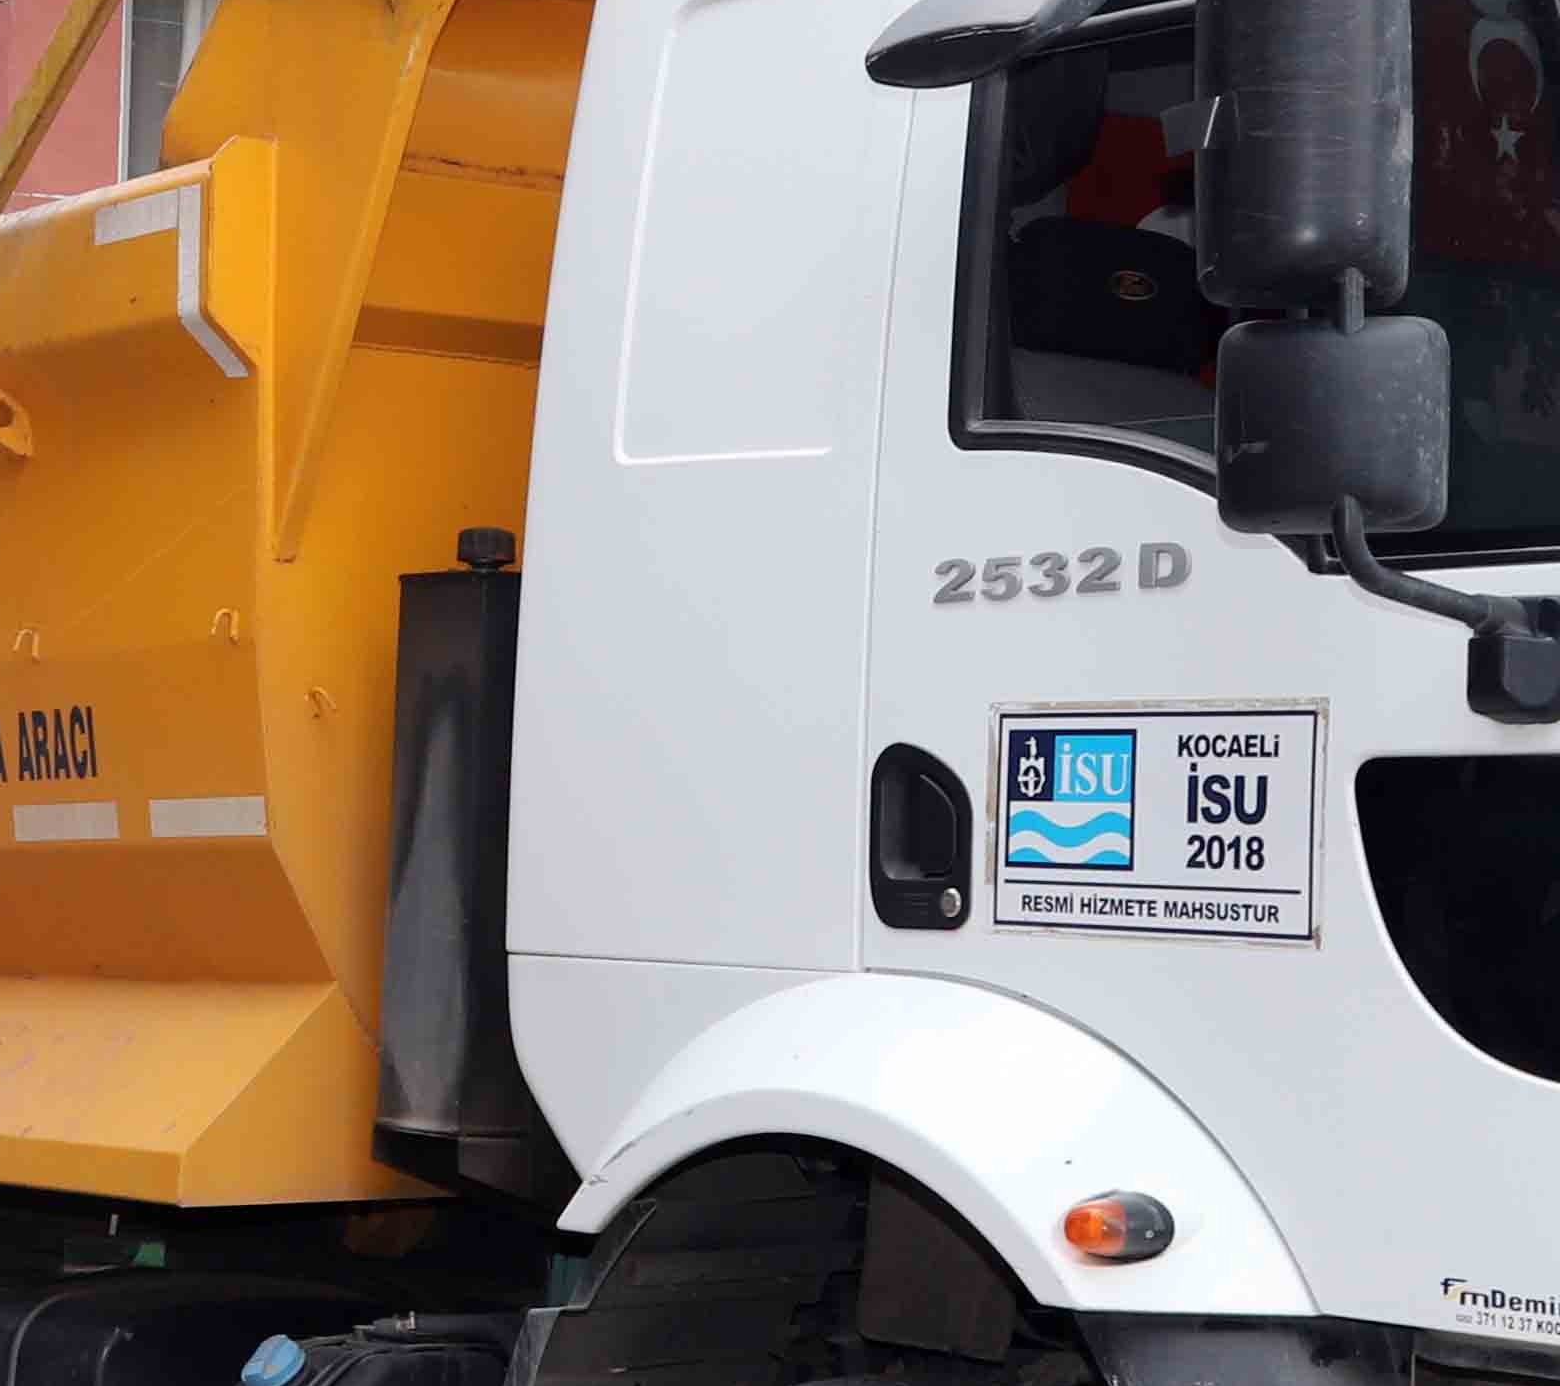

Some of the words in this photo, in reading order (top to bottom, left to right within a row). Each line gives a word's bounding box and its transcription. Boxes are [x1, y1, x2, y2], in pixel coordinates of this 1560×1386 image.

[933, 546, 1122, 603] 2532
[1138, 542, 1193, 589] D
[18, 705, 98, 781] ARACI
[1057, 743, 1129, 796] İSU
[1186, 763, 1268, 825] İSU
[1186, 835, 1265, 870] 2018
[1021, 893, 1074, 914] RESMİ
[1080, 894, 1157, 918] HİZMETE
[1164, 900, 1280, 923] MAHSUSTUR
[1477, 1312, 1496, 1327] 371
[1502, 1316, 1515, 1330] 12
[1518, 1317, 1532, 1332] 37
